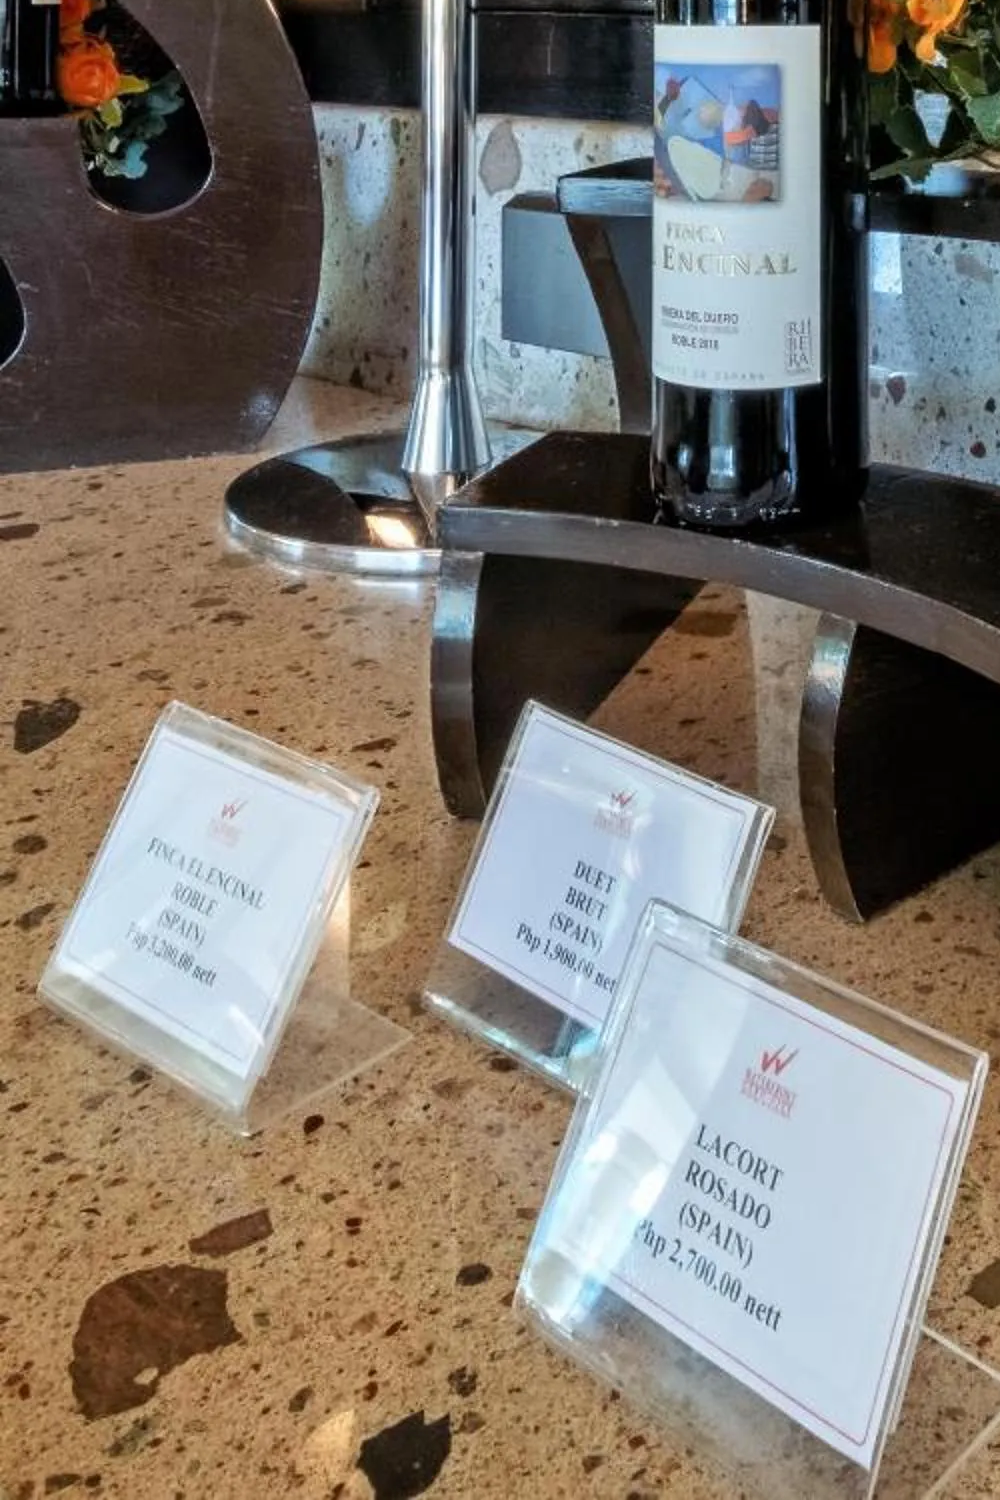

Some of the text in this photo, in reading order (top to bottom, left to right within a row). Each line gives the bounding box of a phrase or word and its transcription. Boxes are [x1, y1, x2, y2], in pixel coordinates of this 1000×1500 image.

[666, 220, 727, 245] FINCA
[663, 243, 798, 276] ENCINAL
[205, 866, 266, 911] ENCINAL
[573, 860, 617, 894] DUET
[171, 881, 218, 917] ROBLE
[564, 885, 608, 921] BRUT
[157, 907, 207, 948] (SPAIN)
[516, 922, 541, 953] Php
[549, 911, 604, 957] (SPAIN)
[191, 965, 217, 988] nett
[694, 1123, 785, 1192] LACORT
[685, 1159, 772, 1230] ROSADO
[678, 1200, 754, 1270] (SPAIN)
[668, 1238, 743, 1304] 2,700.00
[743, 1292, 782, 1333] nett
